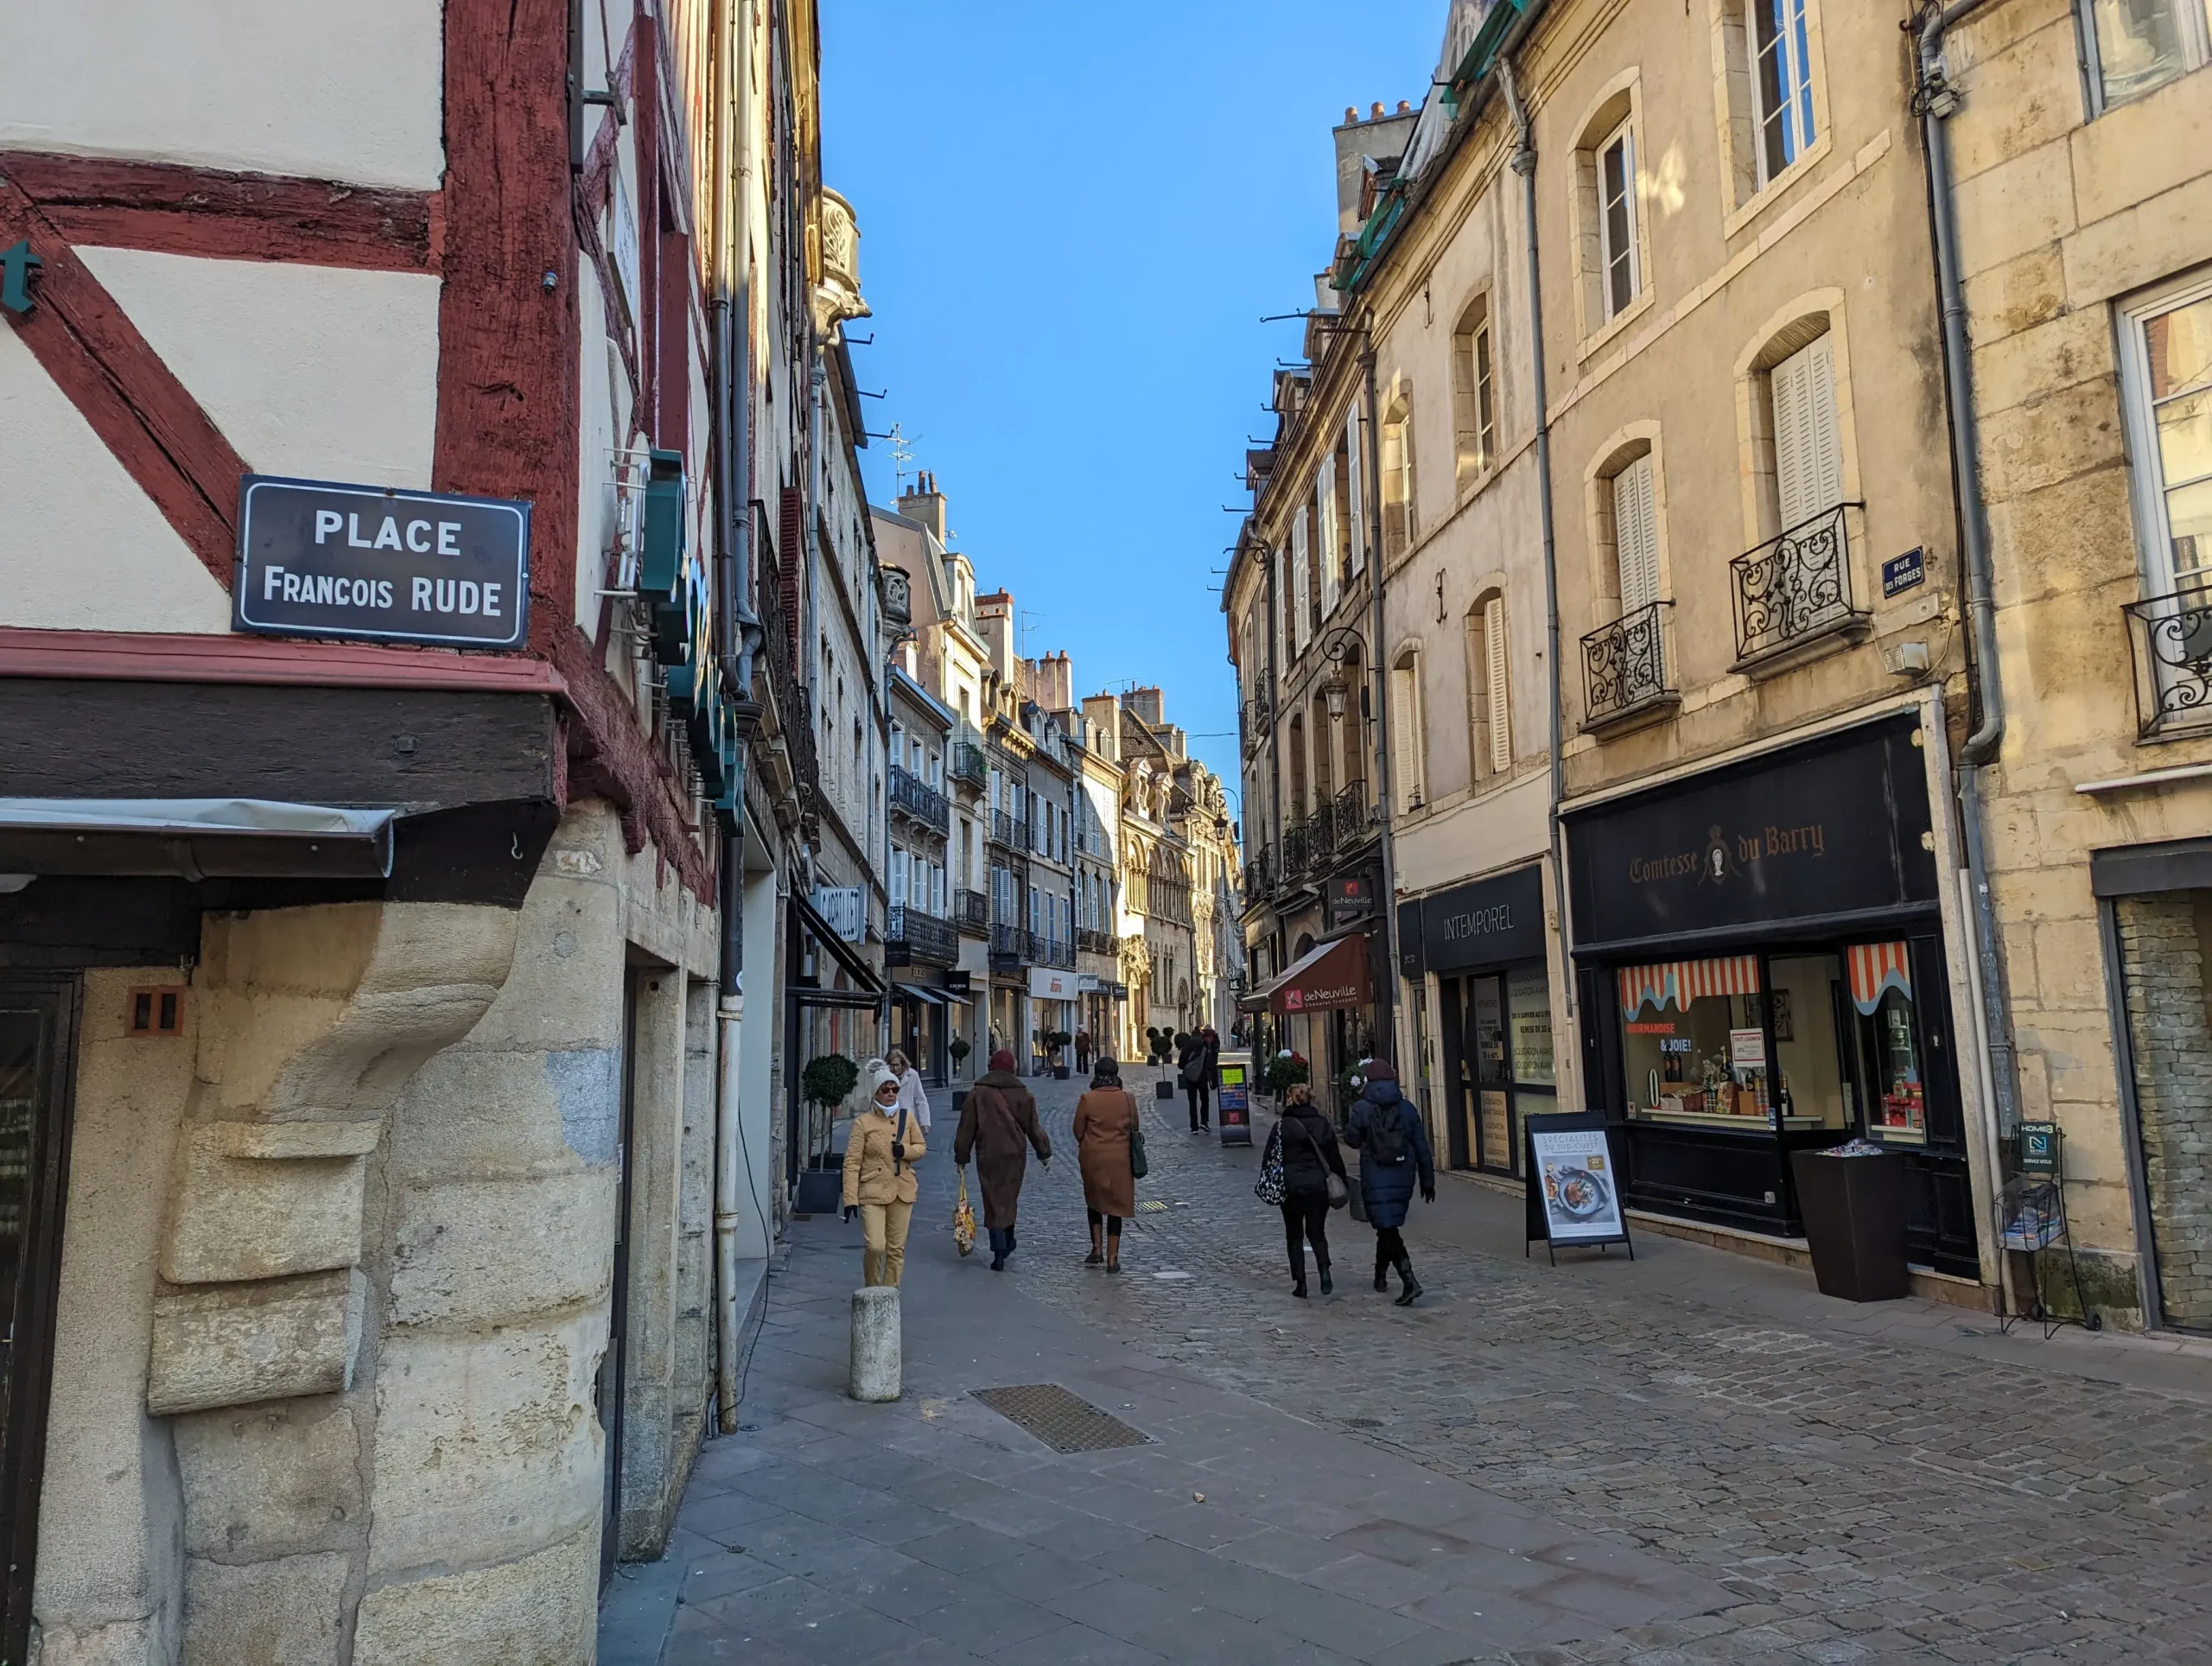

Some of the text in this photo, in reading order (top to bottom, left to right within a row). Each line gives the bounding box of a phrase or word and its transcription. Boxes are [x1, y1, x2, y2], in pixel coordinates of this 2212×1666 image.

[315, 509, 461, 556] PLACE
[1893, 557, 1910, 573] RUE
[1885, 567, 1922, 591] DES FORGES
[264, 564, 501, 616] FRANÇOIS RUDE
[1630, 824, 1825, 883] Comtesse du Barry
[1332, 896, 1373, 905] deNeuville
[1444, 904, 1515, 941] INTEMPOREL
[1304, 985, 1357, 1002] deNeuville
[1510, 987, 1535, 997] LIQUIDATION
[1520, 1025, 1535, 1033] REMISE
[1541, 1025, 1547, 1033] 30
[1626, 1023, 1675, 1034] GOURMANDISE
[1513, 1046, 1538, 1056] LIQUIDATION
[1661, 1039, 1668, 1052] &
[1514, 1061, 1539, 1070] LIQUIDATION
[1542, 1133, 1599, 1144] SPÉCIALITÉS
[1558, 1142, 1598, 1151] SUD-OUEST
